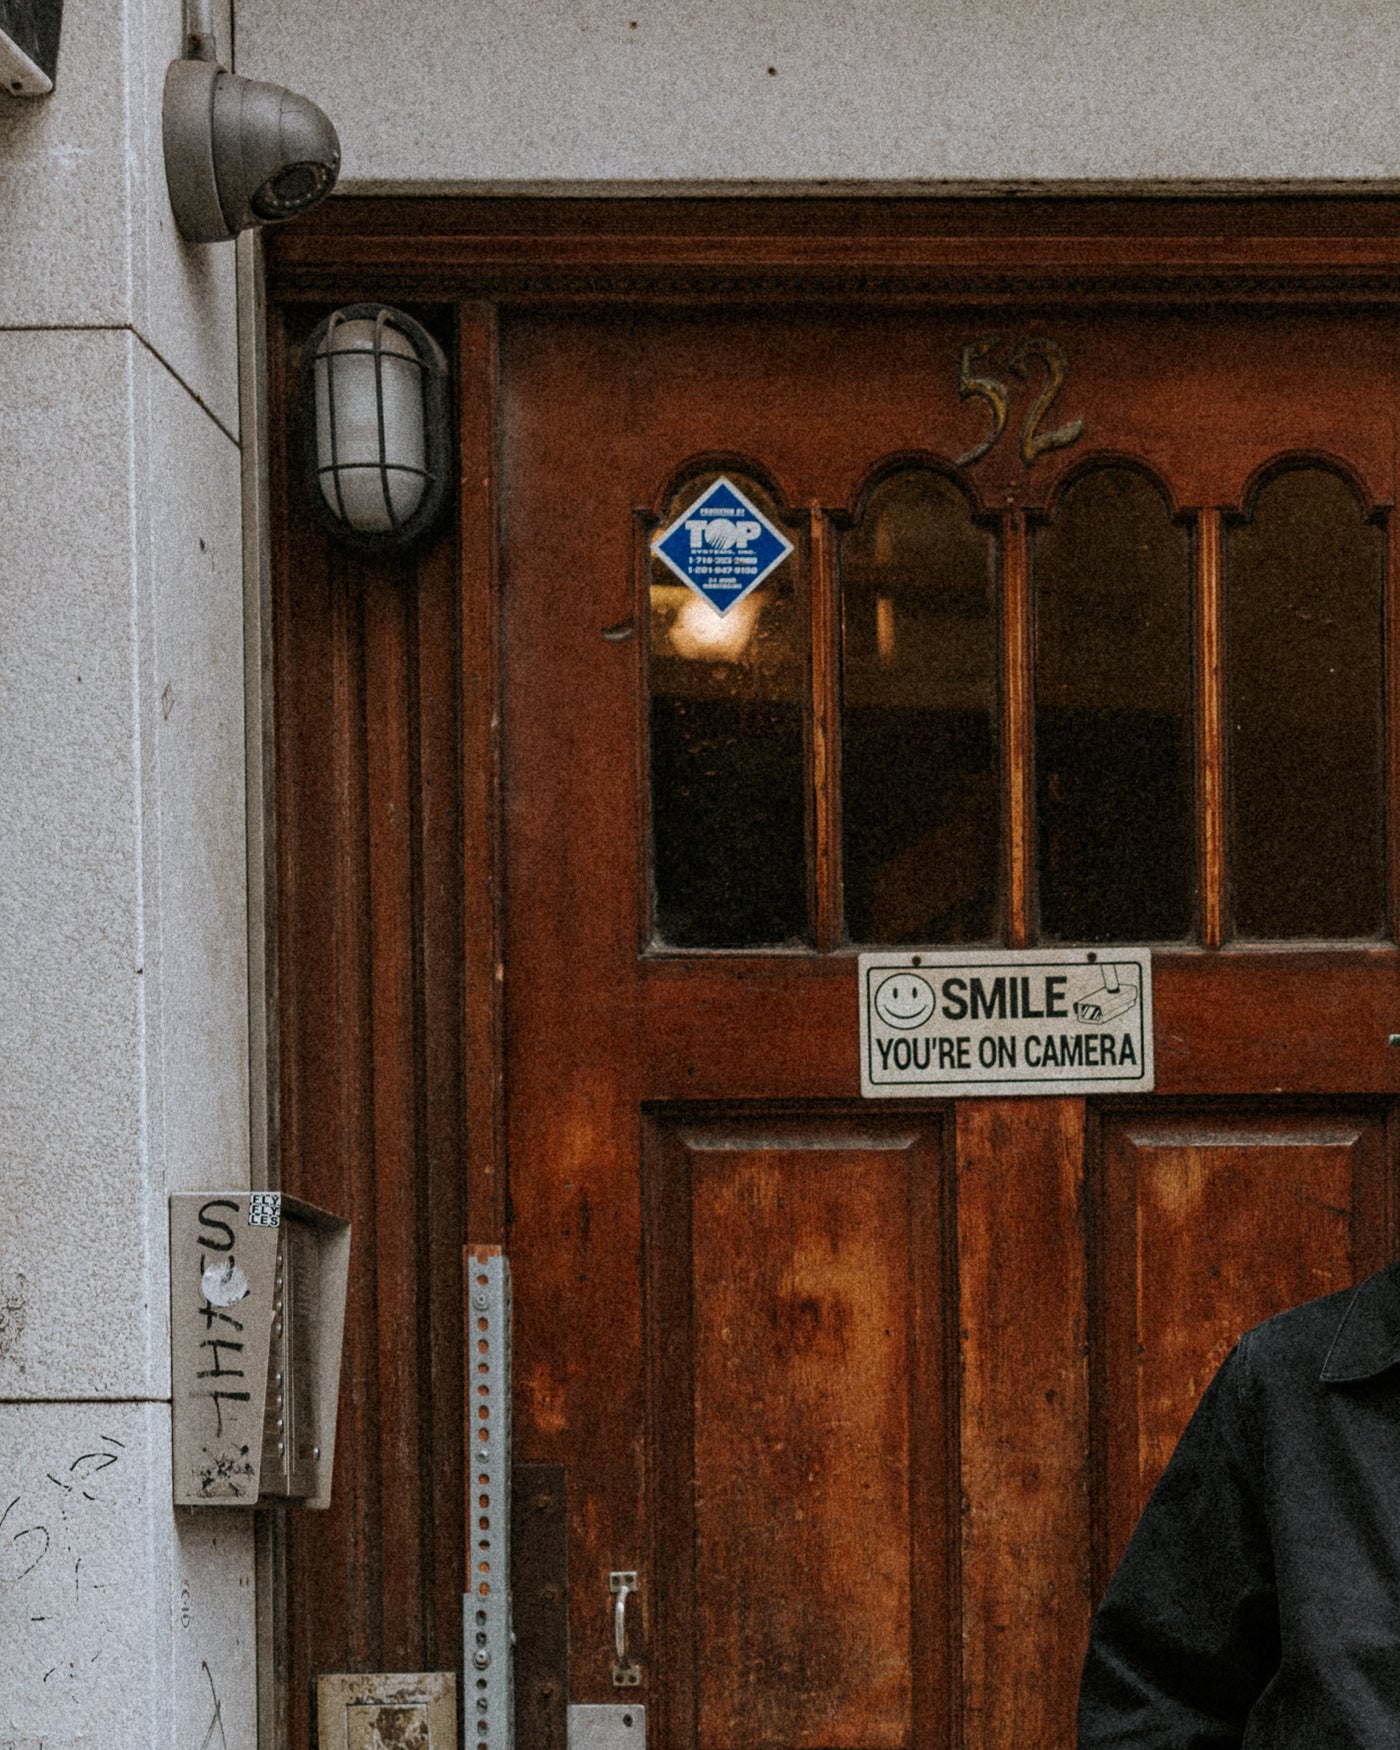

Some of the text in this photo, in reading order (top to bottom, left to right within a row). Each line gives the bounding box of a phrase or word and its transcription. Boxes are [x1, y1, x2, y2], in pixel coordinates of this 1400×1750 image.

[957, 334, 1083, 468] 52
[685, 518, 762, 550] TOP
[941, 976, 1069, 1021] SMILE
[875, 1033, 1137, 1071] YOU'RE ON CAMERA
[252, 1205, 279, 1215] FLY
[253, 1194, 279, 1205] FLY
[251, 1215, 278, 1226] LES
